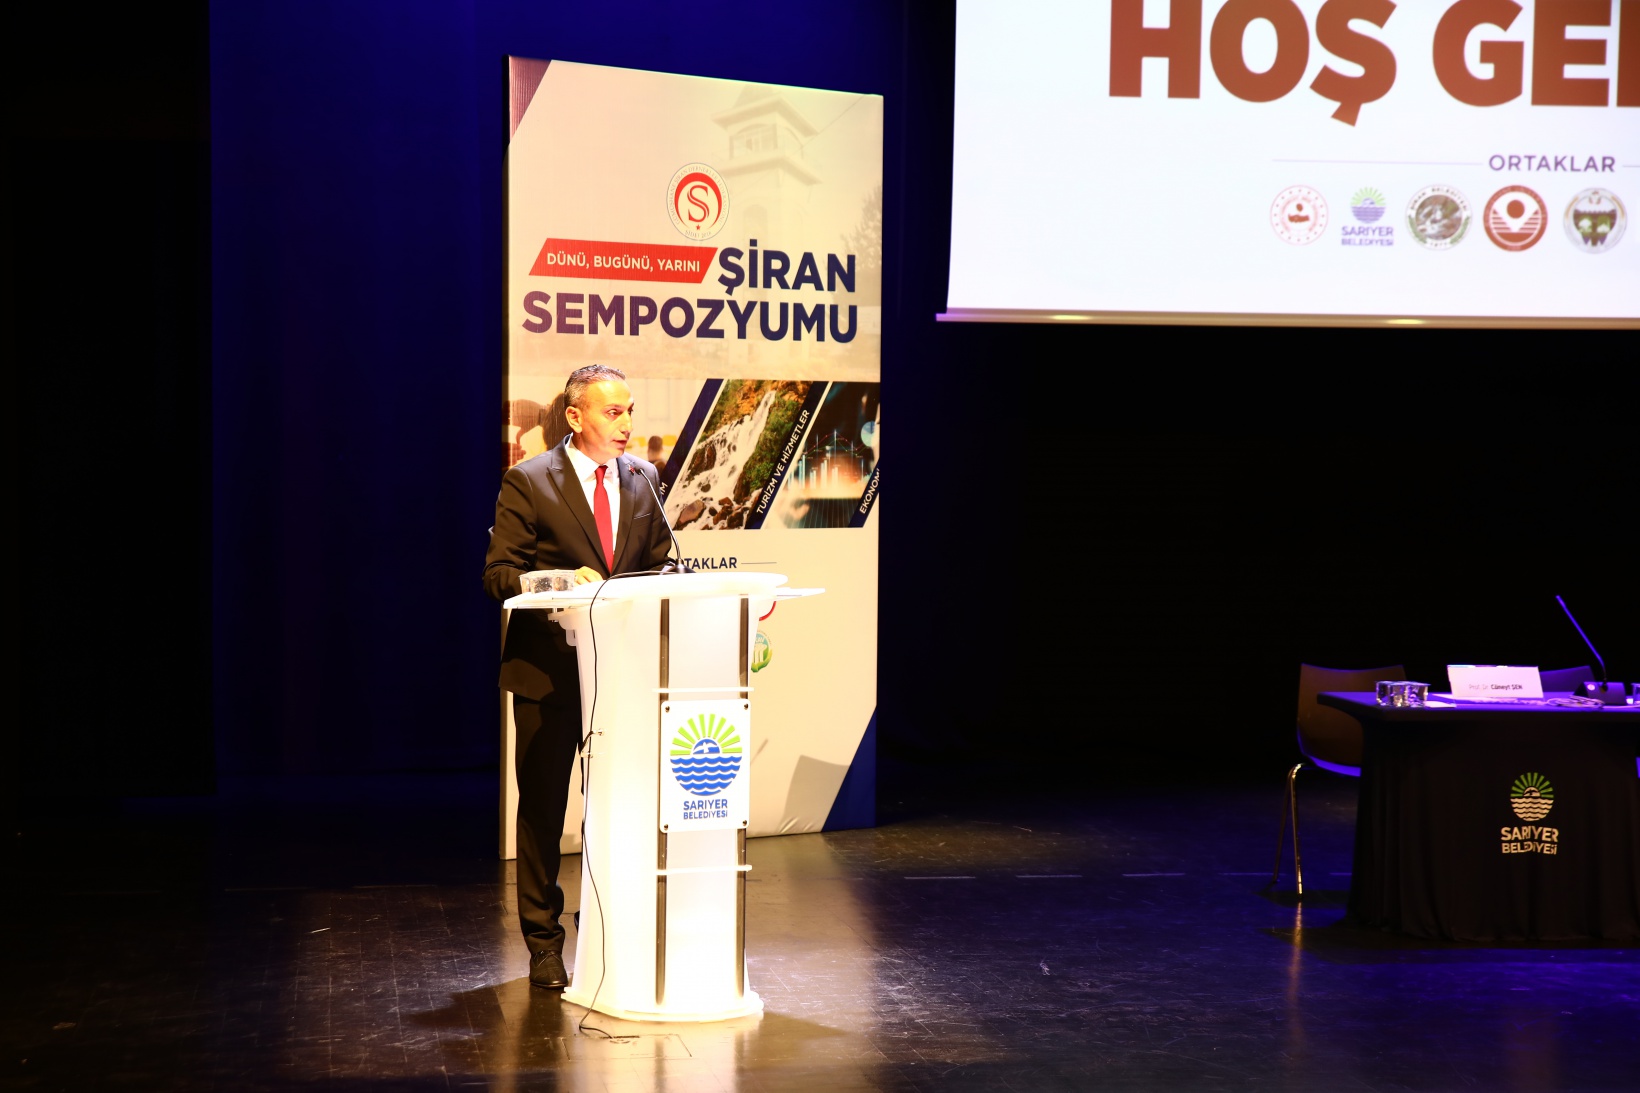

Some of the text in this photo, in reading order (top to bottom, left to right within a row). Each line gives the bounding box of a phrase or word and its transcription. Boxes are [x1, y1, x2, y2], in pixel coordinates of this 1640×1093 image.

[1109, 0, 1640, 127] HOŞ GE
[1489, 154, 1616, 173] ORTAKLAR
[1341, 226, 1394, 237] SARIYER
[547, 251, 700, 272] DÜNÜ, BUGÜNÜ, YARINI
[717, 239, 856, 296] ŞİRAN
[521, 291, 858, 344] SEMPOZYUMU
[756, 409, 810, 514] TURİZM VE HİZMETLER
[683, 556, 738, 570] TAKLAR
[683, 799, 728, 811] SARIYER
[683, 810, 728, 820] BELEDİYESİ
[1500, 825, 1559, 842] SARIYER
